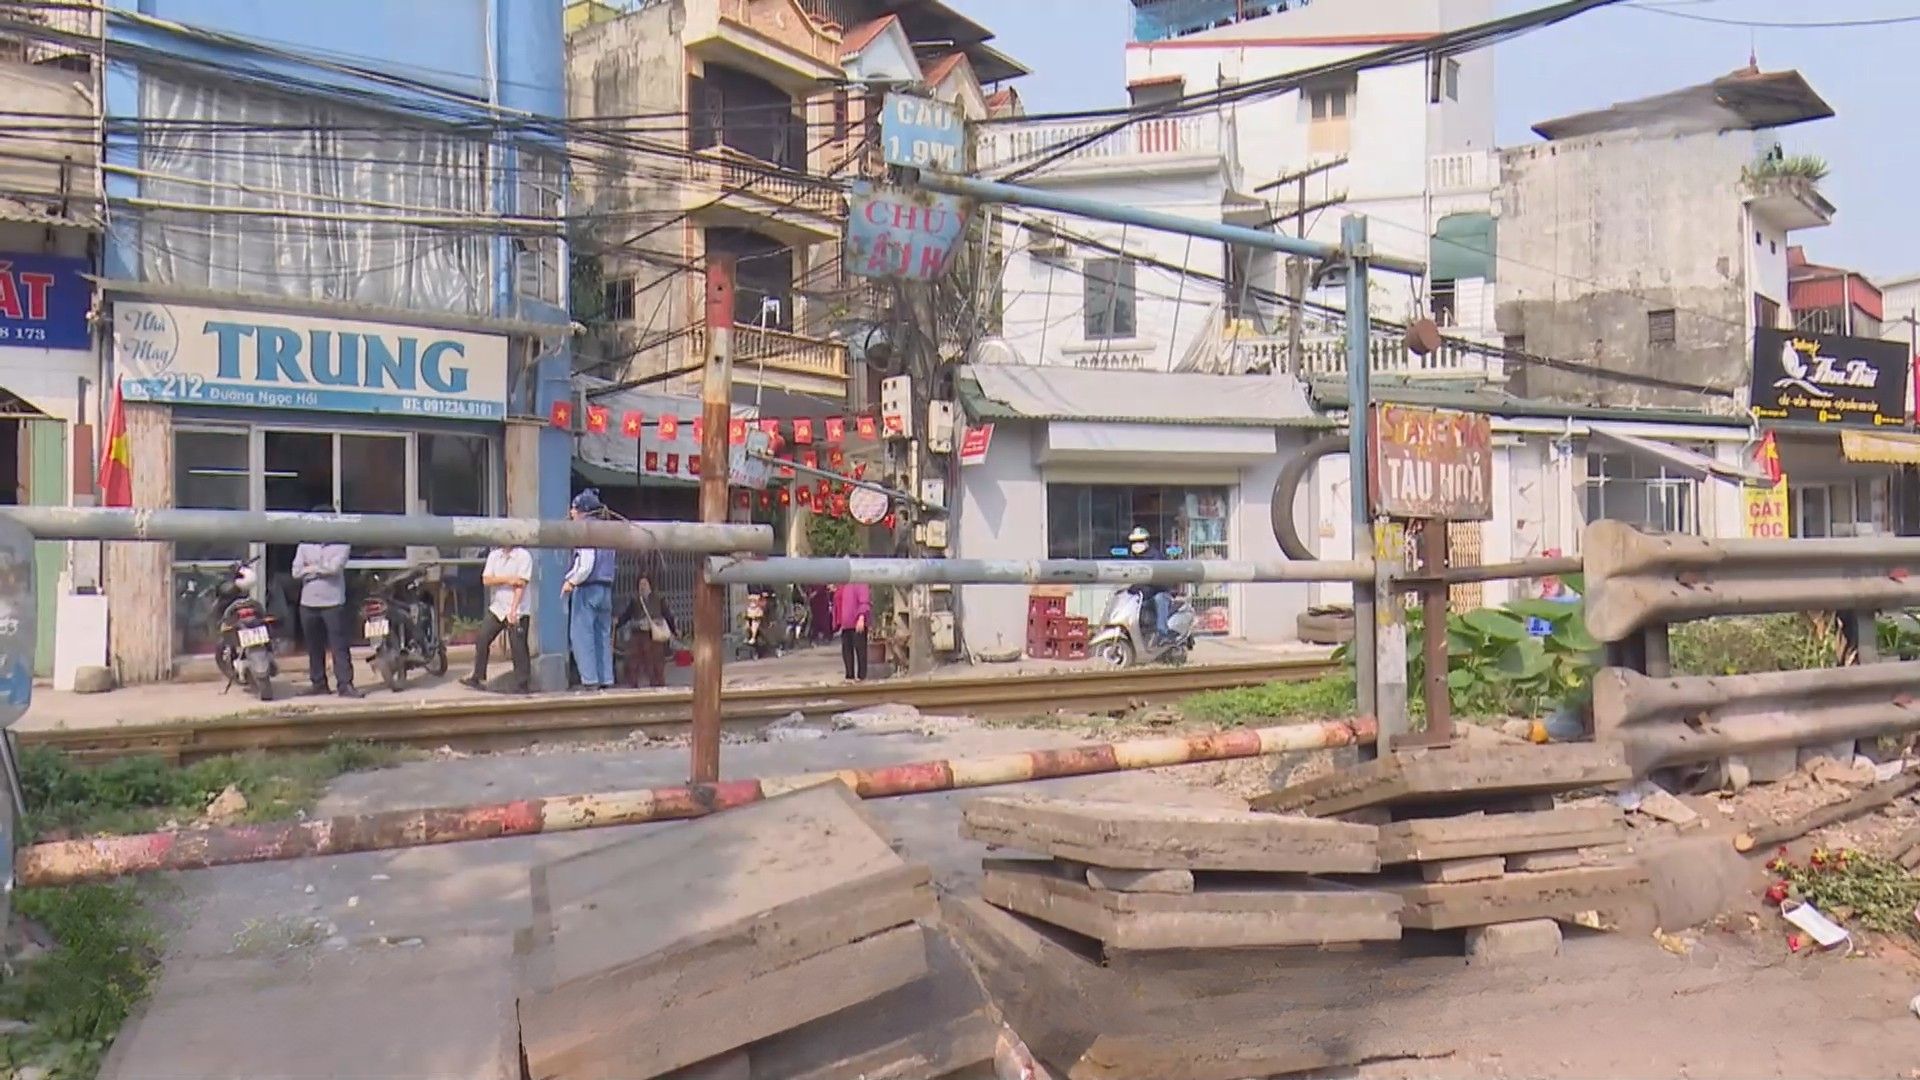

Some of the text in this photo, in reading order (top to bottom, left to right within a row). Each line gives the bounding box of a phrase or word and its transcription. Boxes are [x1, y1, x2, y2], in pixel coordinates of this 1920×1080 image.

[203, 321, 469, 394] TRUNG
[161, 373, 204, 398] 212
[1387, 448, 1433, 501] TÀU
